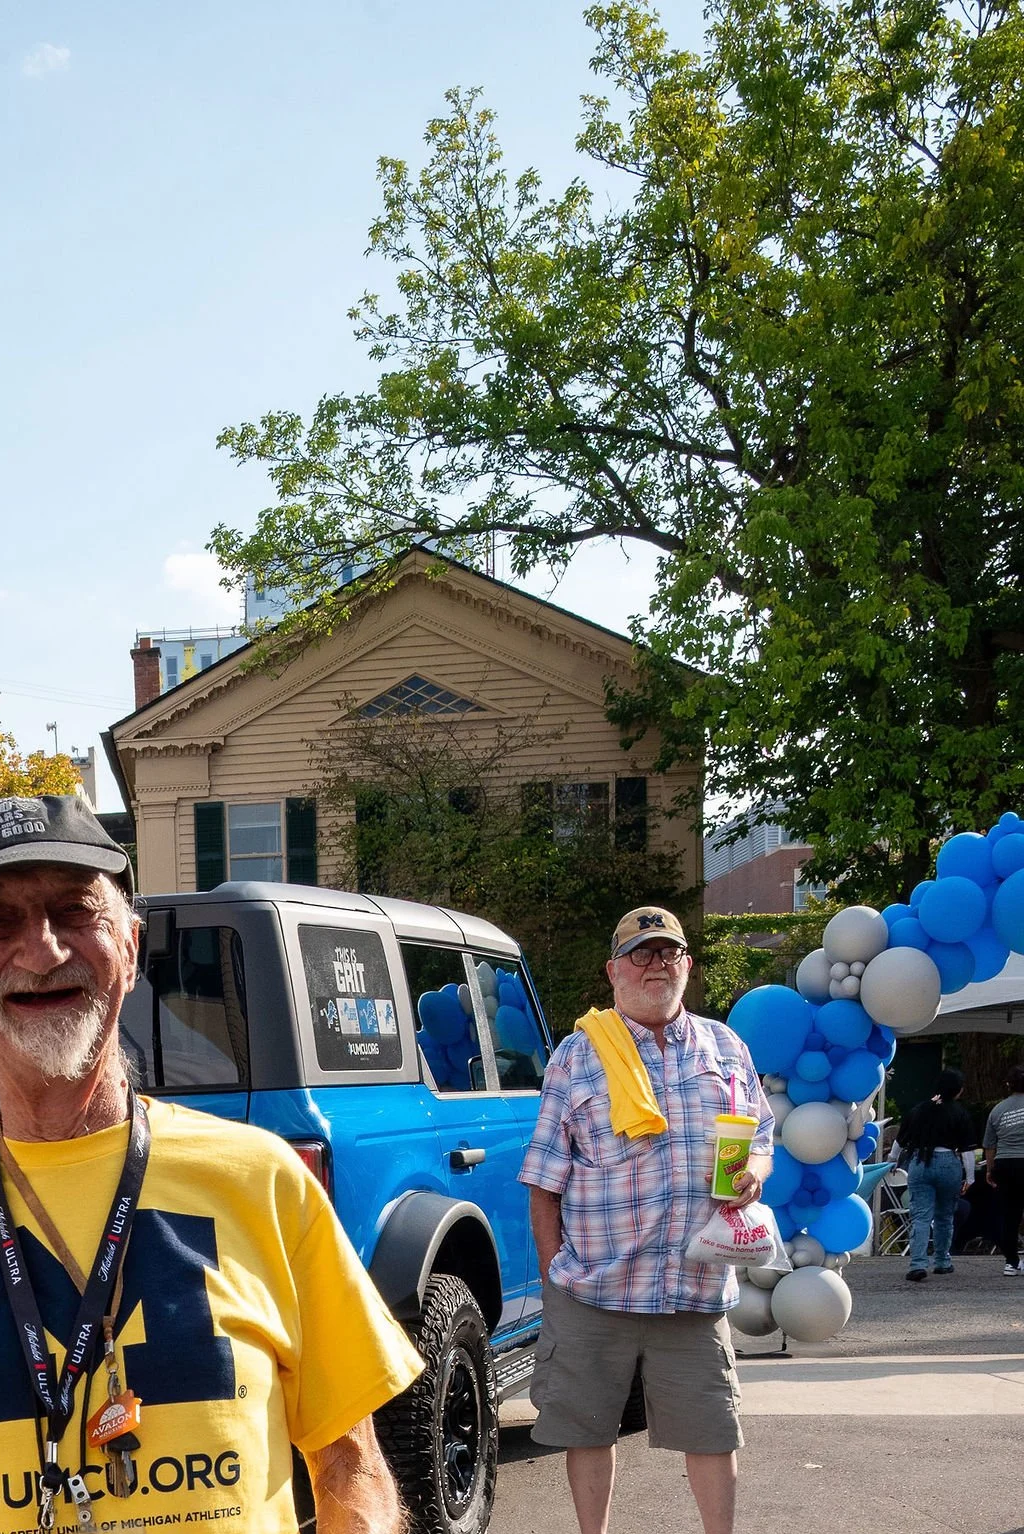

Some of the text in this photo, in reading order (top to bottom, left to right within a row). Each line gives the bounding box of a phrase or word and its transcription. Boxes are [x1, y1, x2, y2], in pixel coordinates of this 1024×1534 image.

[1, 821, 45, 838] GOOD
[637, 913, 666, 931] M
[335, 946, 357, 964] THIS IS
[333, 961, 367, 993] GRIT
[97, 1197, 132, 1282] Michelob ULTRA
[699, 1237, 715, 1247] Take
[716, 1243, 735, 1252] some
[4, 1247, 22, 1285] ULTRA
[71, 1323, 93, 1364] ULTRA
[92, 1411, 133, 1438] AVALON
[100, 1520, 117, 1531] OF
[121, 1513, 181, 1529] MICHIGAN
[184, 1506, 242, 1522] ATHLETICS
